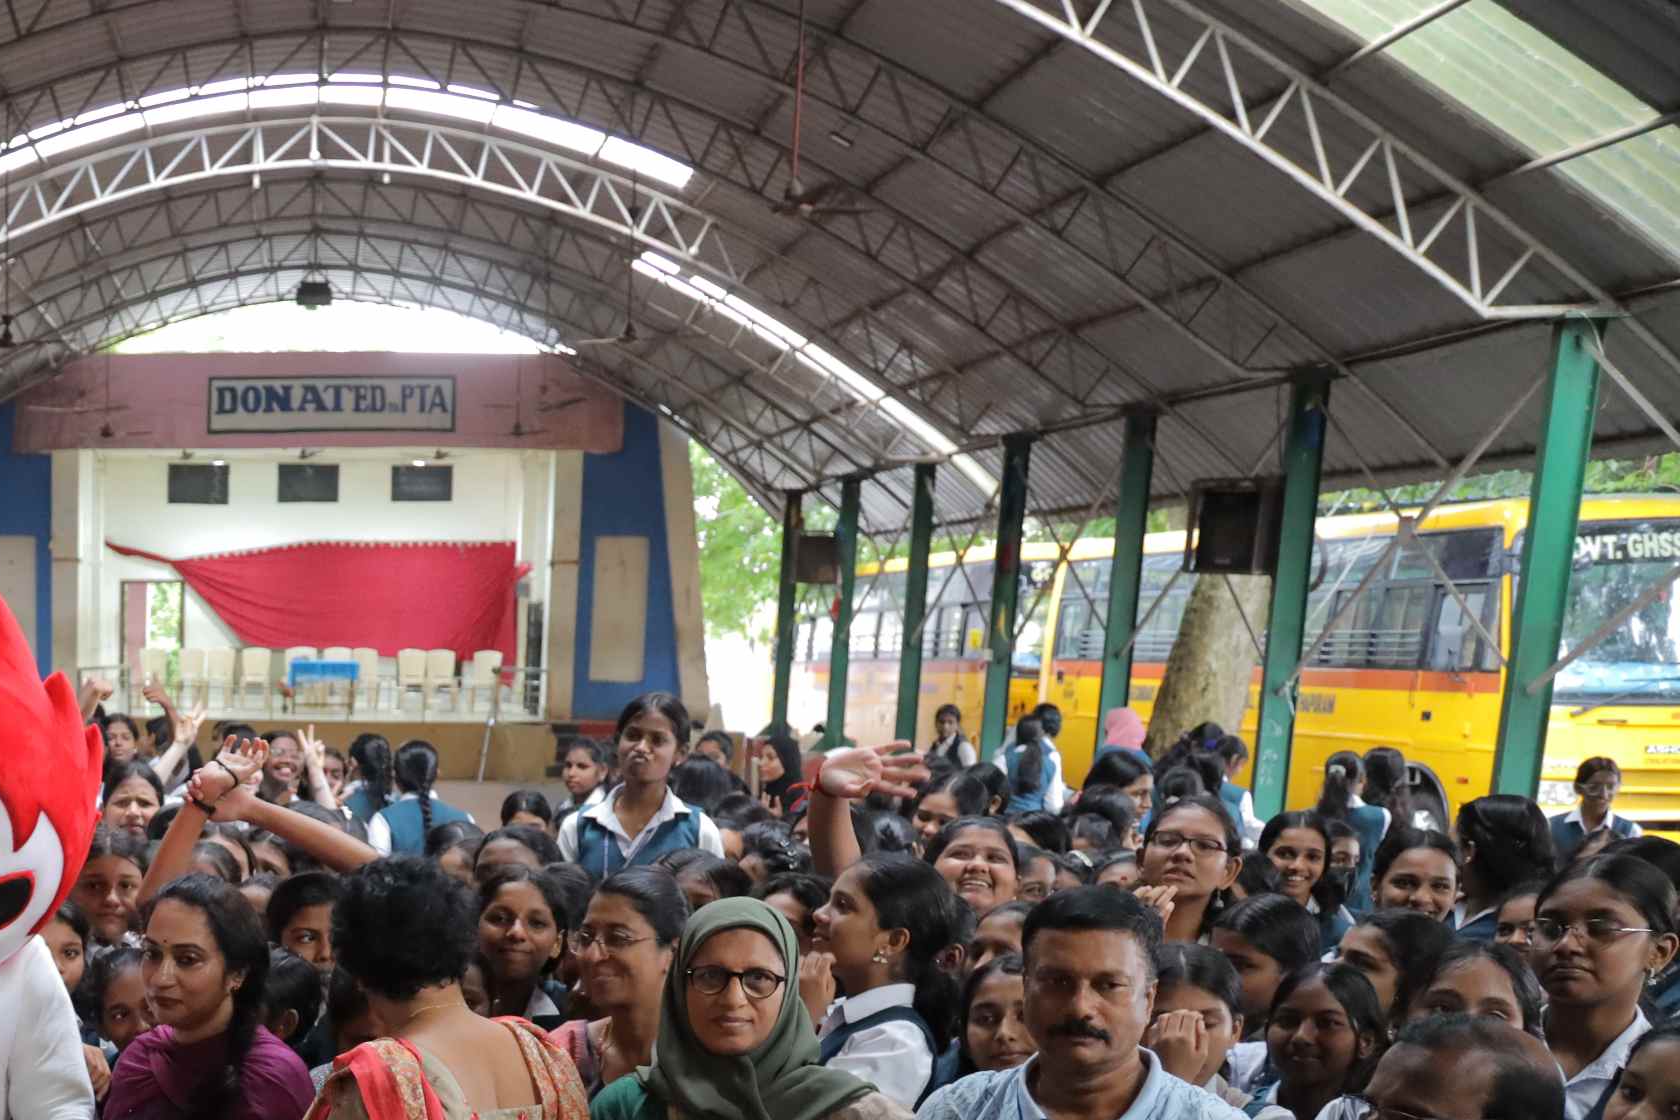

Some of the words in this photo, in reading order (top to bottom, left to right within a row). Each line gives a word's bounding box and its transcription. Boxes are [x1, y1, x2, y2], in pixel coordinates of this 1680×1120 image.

[215, 384, 386, 414] DONATED
[401, 384, 448, 413] PTA
[1573, 535, 1623, 560] OVT.
